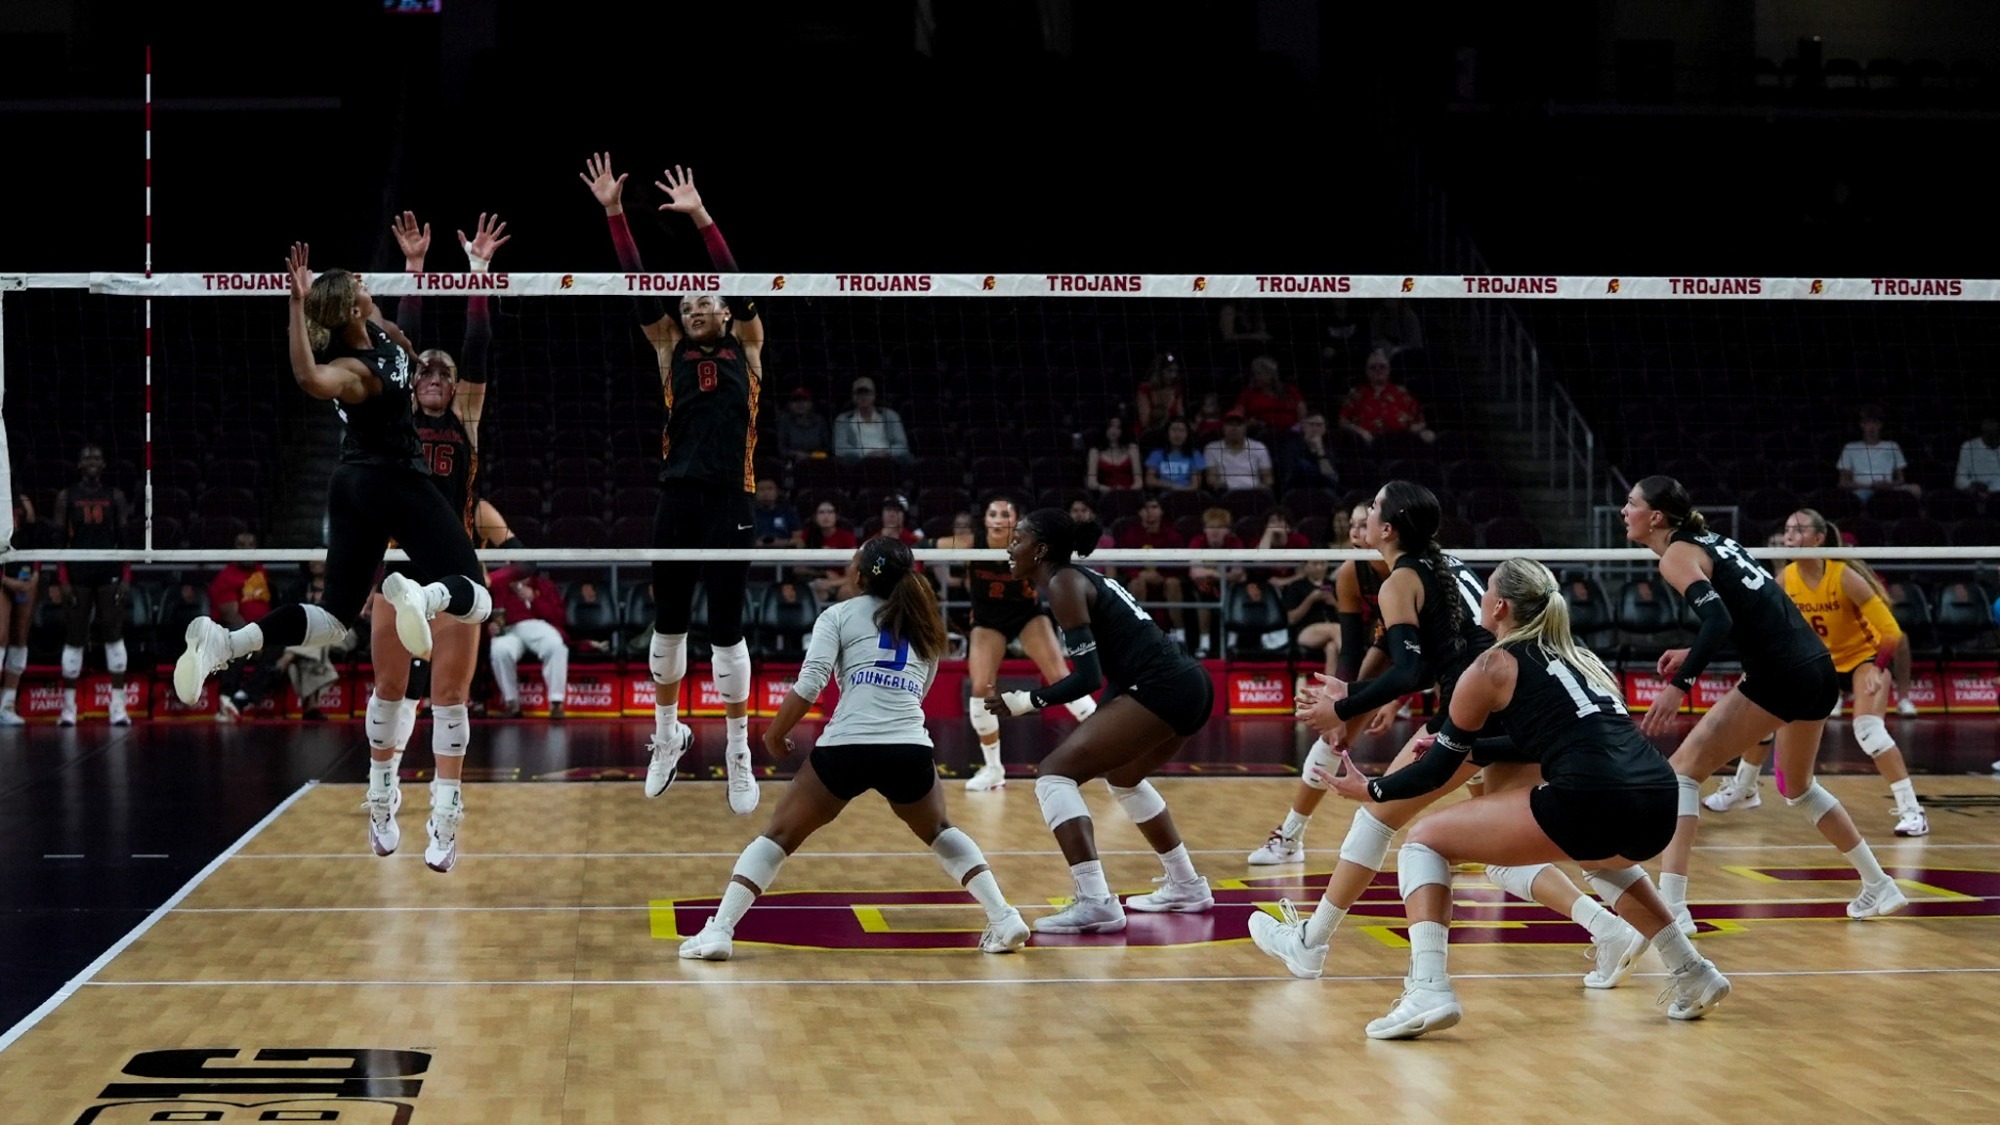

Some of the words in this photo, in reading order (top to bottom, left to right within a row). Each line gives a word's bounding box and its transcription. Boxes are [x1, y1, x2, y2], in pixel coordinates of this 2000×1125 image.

[414, 273, 509, 289] TROJANS
[625, 274, 721, 290] TROJANS
[836, 275, 932, 291] TROJANS
[1047, 275, 1142, 292] TROJANS
[1256, 276, 1351, 293] TROJANS
[1464, 277, 1558, 294] TROJANS
[1669, 278, 1762, 295] TROJANS
[1871, 279, 1962, 296] TROJANS
[697, 360, 718, 392] 8
[422, 442, 454, 476] 16
[1811, 615, 1829, 637] 6
[567, 683, 613, 694] WELLS
[1237, 679, 1283, 691] WELLS
[1634, 678, 1668, 688] WELL
[1699, 680, 1737, 689] WELL
[1953, 679, 1993, 689] WELL
[30, 687, 64, 698] WELL
[1239, 691, 1284, 703] FARGO
[1955, 690, 1998, 701] FARGO
[567, 694, 613, 707] FARGO
